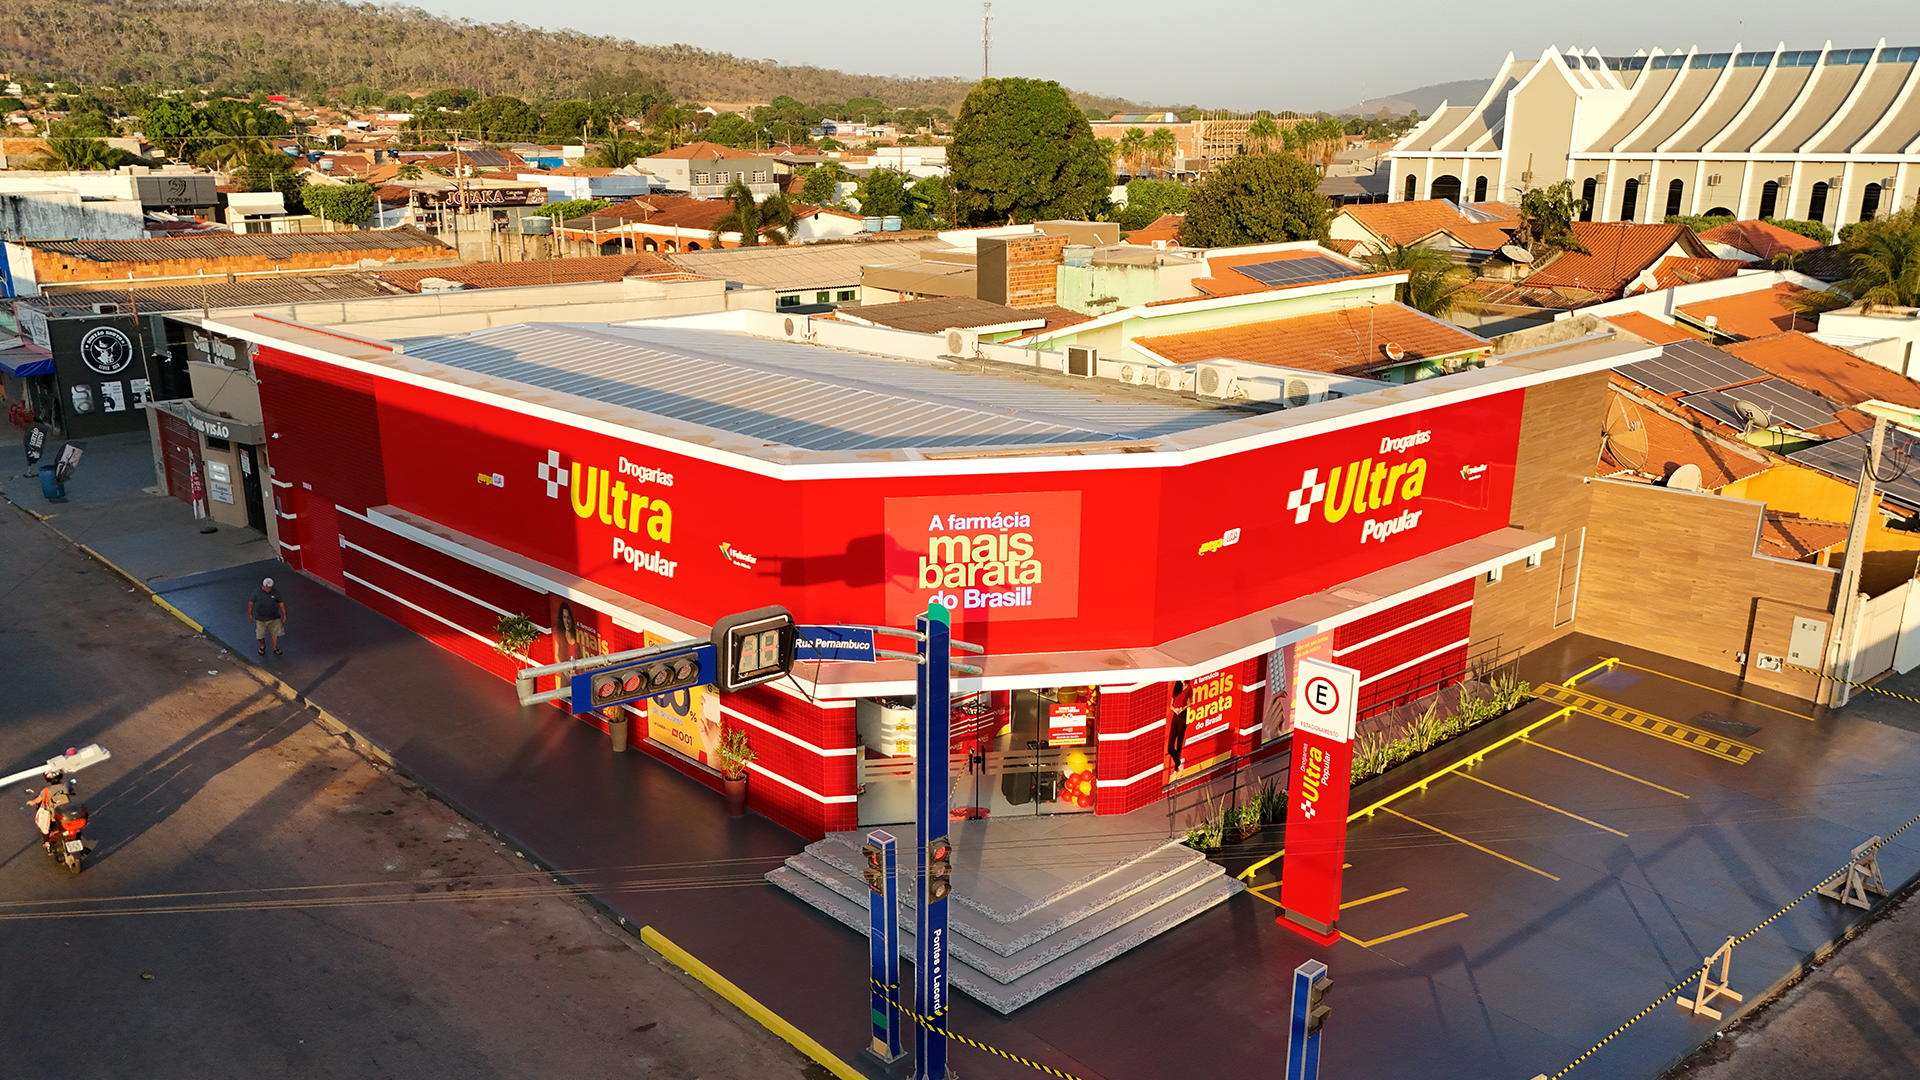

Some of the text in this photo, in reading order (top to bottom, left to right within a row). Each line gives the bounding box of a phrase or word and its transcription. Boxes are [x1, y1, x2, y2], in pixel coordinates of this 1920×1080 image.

[204, 422, 229, 438] VISÃO
[1379, 430, 1431, 454] Drogarias
[619, 456, 674, 487] Drogarias
[571, 462, 672, 544] Ultra
[1324, 457, 1427, 523] Ultra
[929, 511, 1031, 531] A farmácia
[1360, 509, 1423, 543] Popular
[613, 537, 677, 578] Popular
[929, 528, 1034, 564] mais
[919, 551, 1042, 589] barata
[929, 586, 1033, 610] do Brasil!
[576, 629, 609, 655] mais
[795, 638, 871, 650] Rua Pernambuco
[1193, 671, 1234, 705] mais
[1198, 671, 1219, 683] farmácia
[1316, 684, 1328, 706] E
[660, 709, 684, 727] desconto
[1186, 695, 1233, 725] barata
[1195, 713, 1222, 730] do Brasil
[1300, 721, 1339, 738] ESTACIONAMENTO
[1300, 743, 1308, 772] Drogarias
[1321, 751, 1331, 786] Popular
[1302, 747, 1322, 802] Ultra
[933, 928, 942, 966] Pontes
